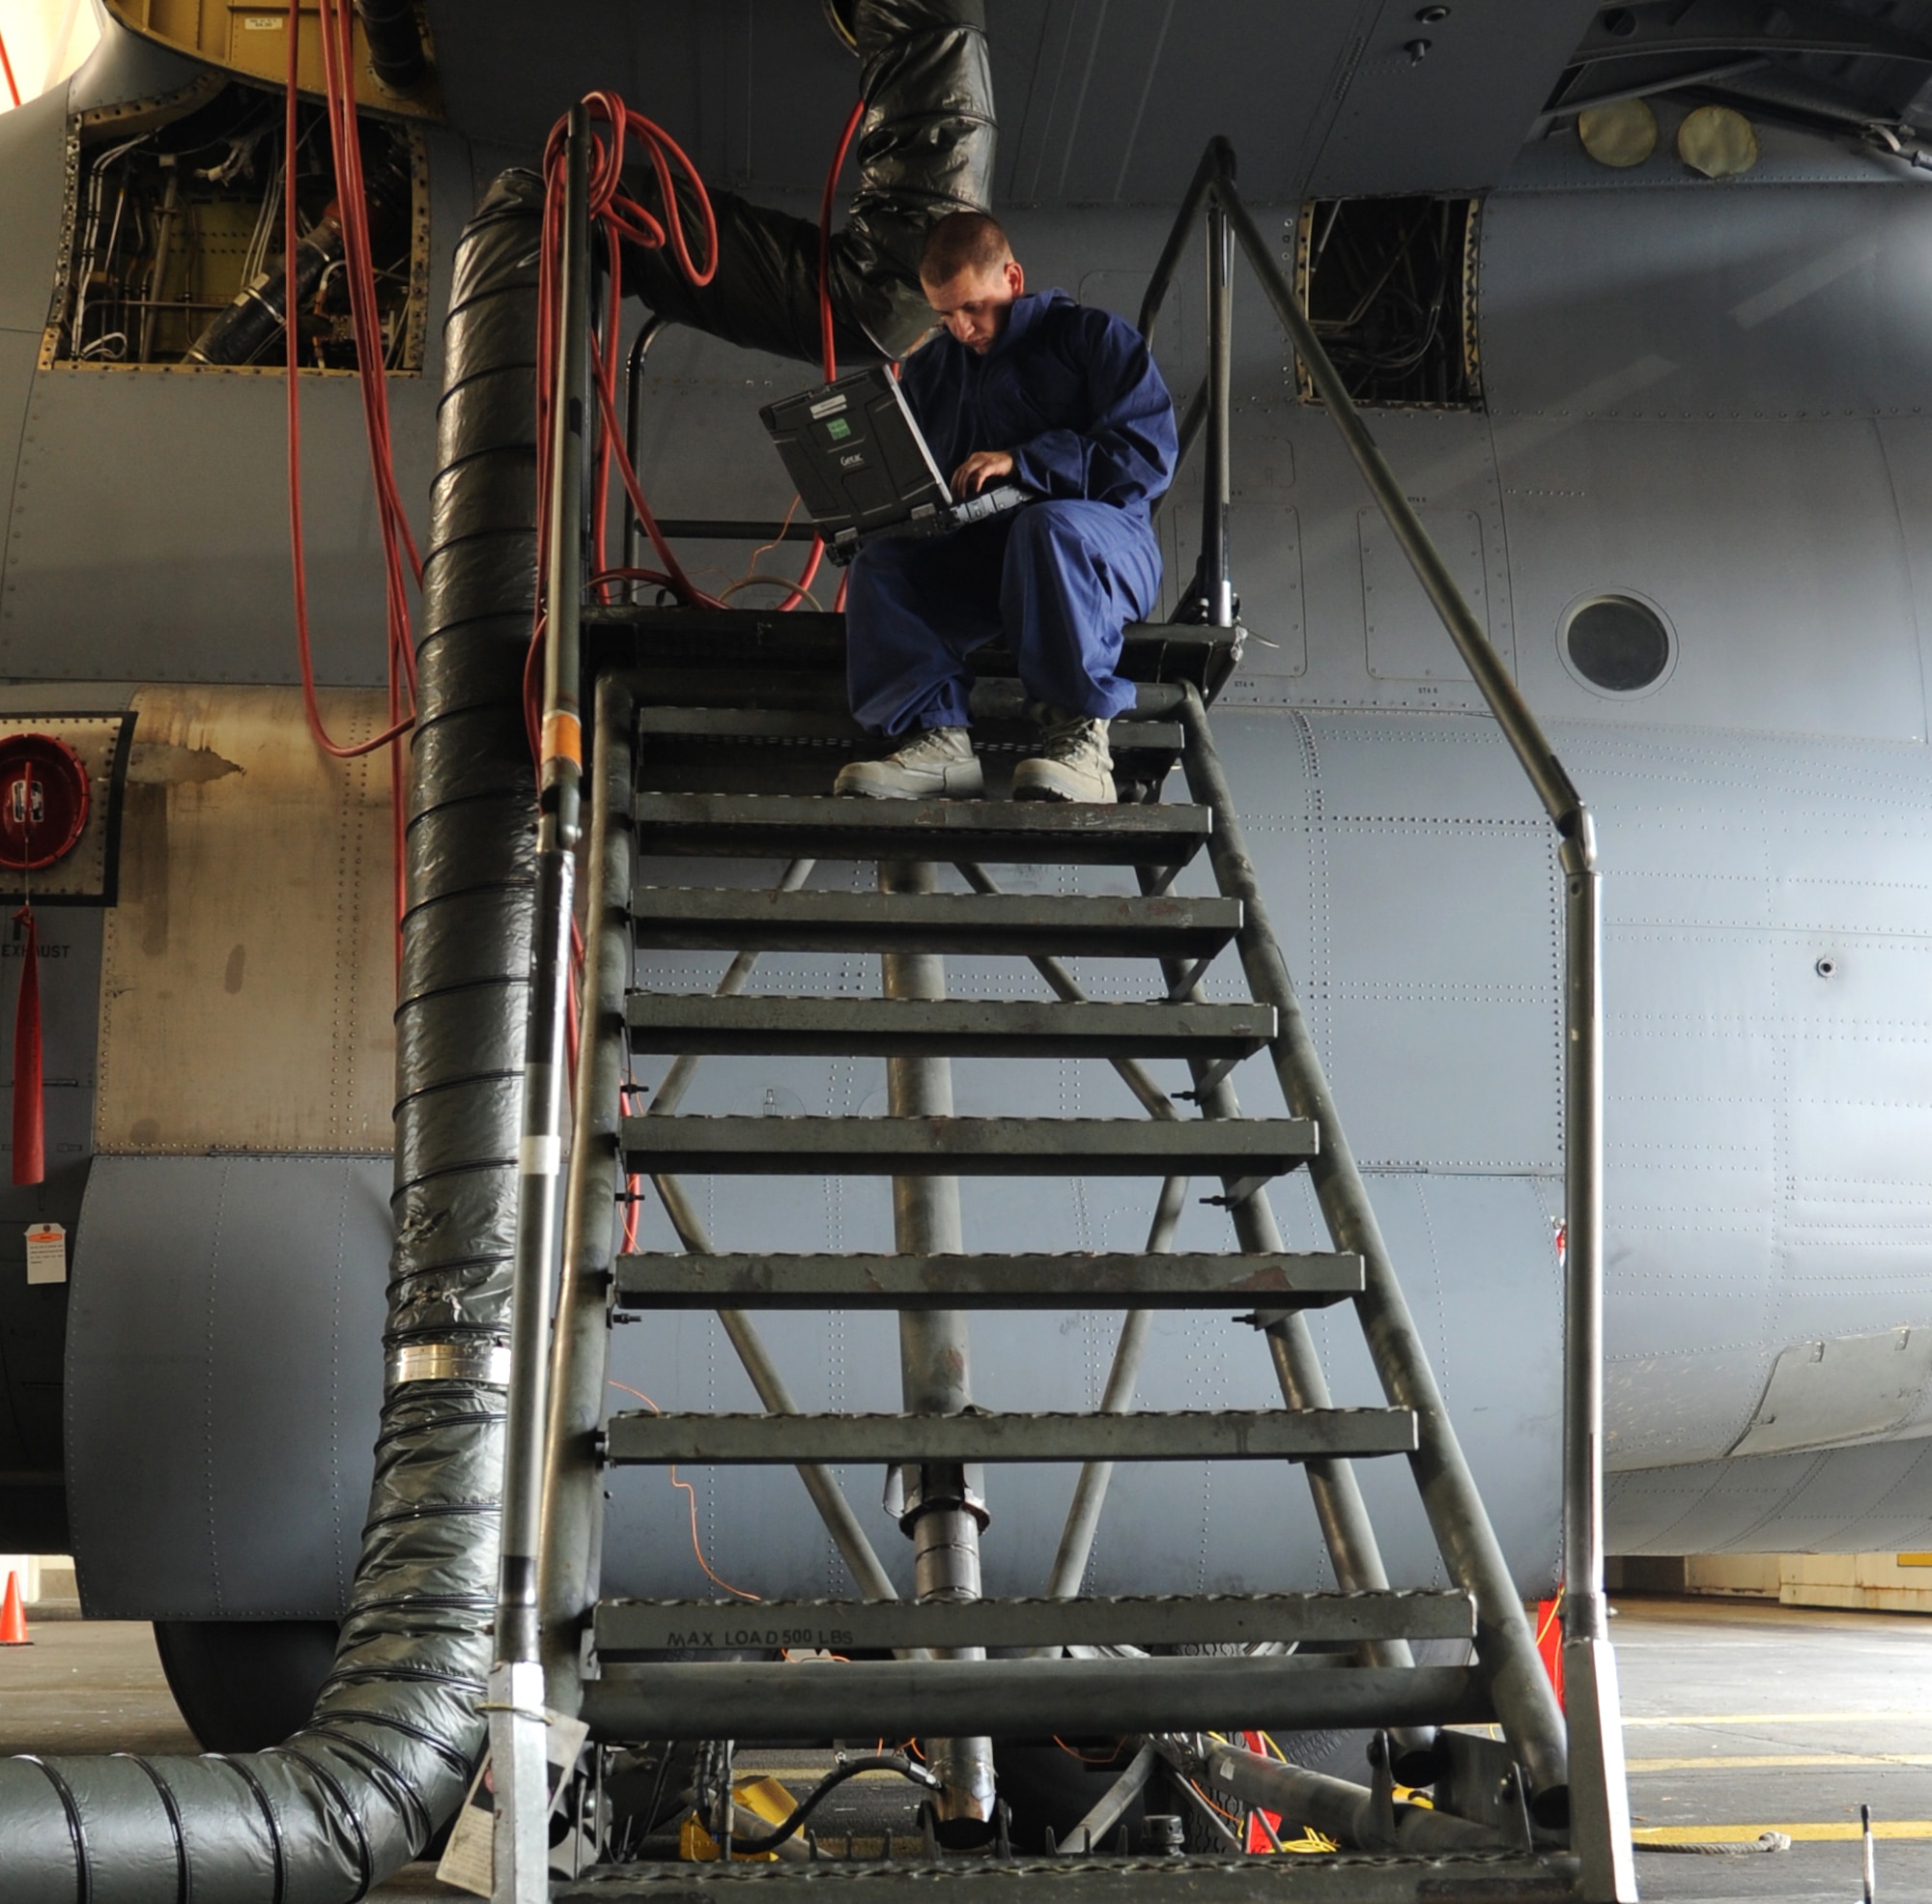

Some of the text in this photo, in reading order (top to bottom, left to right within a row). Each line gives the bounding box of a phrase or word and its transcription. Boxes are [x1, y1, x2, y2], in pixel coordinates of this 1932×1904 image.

[667, 1629, 854, 1647] MAX LOAD 500 LBS
